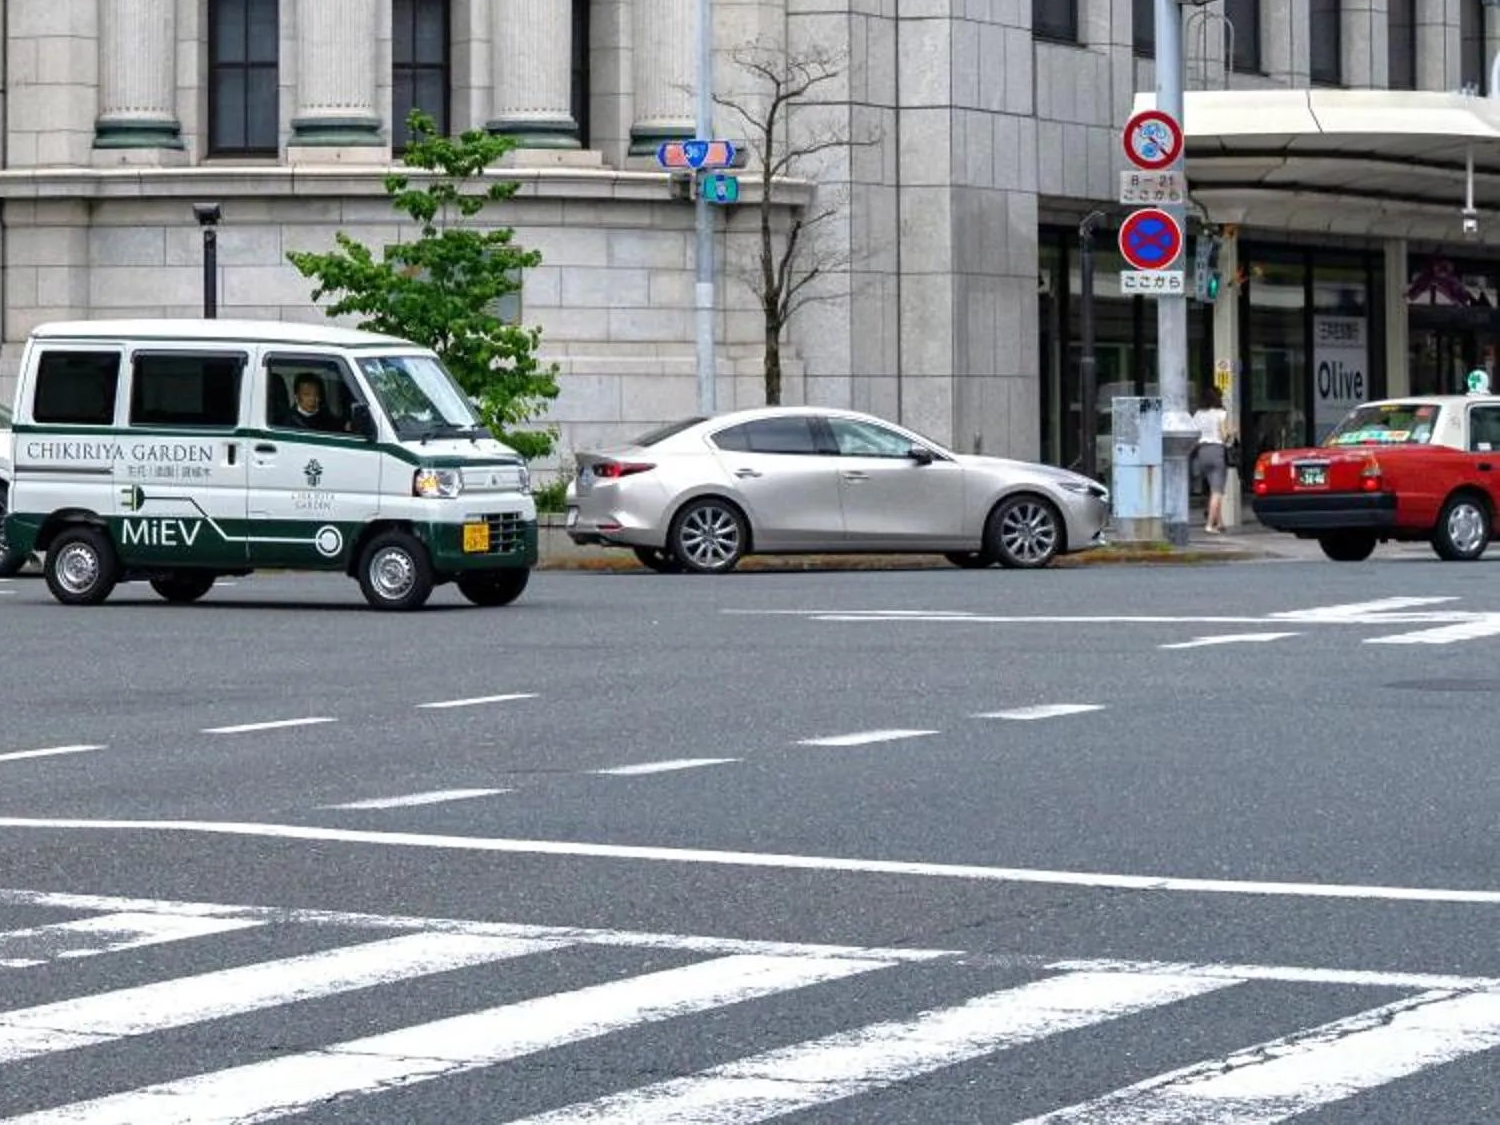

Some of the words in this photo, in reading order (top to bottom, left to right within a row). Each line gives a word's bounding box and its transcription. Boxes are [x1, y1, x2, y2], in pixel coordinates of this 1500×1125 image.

[1318, 360, 1364, 401] Olive
[27, 442, 125, 460] CHIKIRIYA
[131, 444, 213, 462] GARDEN
[121, 518, 202, 546] MiEV
